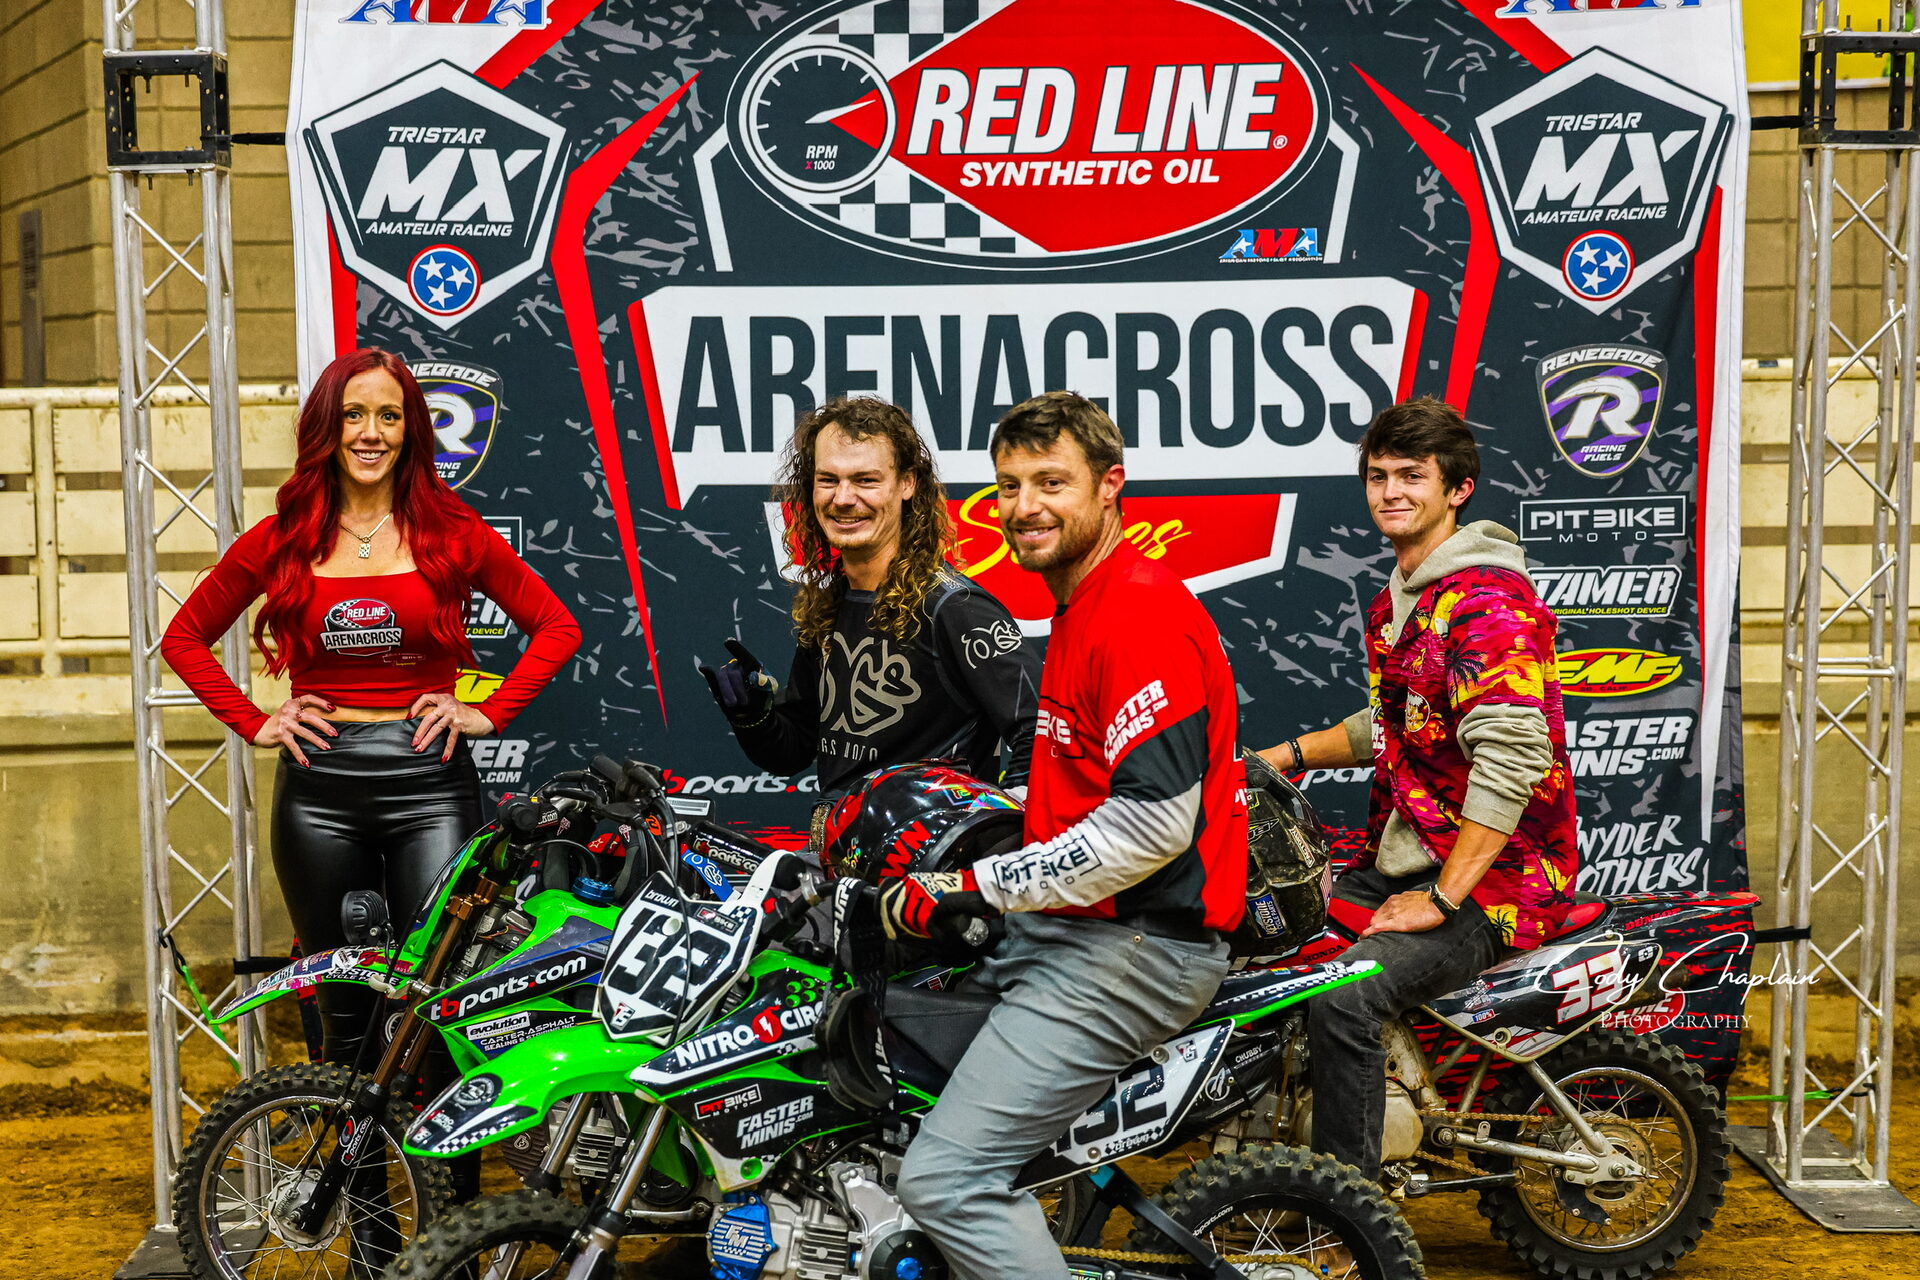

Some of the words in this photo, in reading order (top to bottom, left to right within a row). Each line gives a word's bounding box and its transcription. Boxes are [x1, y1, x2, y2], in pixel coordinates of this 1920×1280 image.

[906, 67, 1076, 155] RED
[1090, 63, 1283, 154] LINE
[1546, 112, 1643, 132] TRISTAR
[388, 126, 486, 144] TRISTAR
[806, 145, 838, 159] RPM
[959, 159, 1155, 188] SYNTHETIC
[1163, 158, 1220, 184] OIL
[1513, 130, 1700, 210] MX
[356, 146, 543, 222] MX
[1522, 209, 1604, 225] AMATEUR
[1606, 206, 1667, 221] RACING
[366, 222, 448, 236] AMATEUR
[450, 223, 513, 237] RACING
[1219, 227, 1322, 259] AMA
[1541, 347, 1662, 376] RENEGADE
[406, 362, 497, 388] NEGADE
[673, 305, 1396, 452] ARENACROSS
[1580, 444, 1627, 453] RACING
[1583, 452, 1622, 462] FUELS
[1558, 531, 1647, 543] MOTO
[1530, 570, 1677, 606] TAMER
[347, 608, 365, 619] RED
[366, 606, 387, 617] LINE
[325, 630, 401, 647] ARENACROSS
[472, 627, 504, 635] DEVICE
[1564, 716, 1693, 748] ASTER
[1565, 748, 1648, 777] INIS
[662, 769, 821, 794] bparts.c
[1576, 814, 1684, 864] NYDER
[1575, 847, 1704, 896] OTHERS
[1018, 875, 1076, 895] MOO
[644, 889, 680, 908] brown
[1624, 908, 1682, 931] DUNLOP
[1303, 945, 1345, 964] HONDA
[430, 956, 587, 1021] tbparts.com
[1552, 948, 1626, 1024] 33
[470, 1015, 528, 1036] evolution
[1472, 1009, 1495, 1022] 100%
[480, 1015, 577, 1046] CARTER-ASPHALT
[484, 1038, 518, 1051] SEALING
[673, 1024, 754, 1067] NITRO
[1235, 1044, 1262, 1063] CHUBBY
[713, 1102, 748, 1117] MOTO
[736, 1095, 814, 1138] FASTER
[740, 1117, 796, 1150] MINIS
[1193, 1205, 1234, 1237] bparts.com
